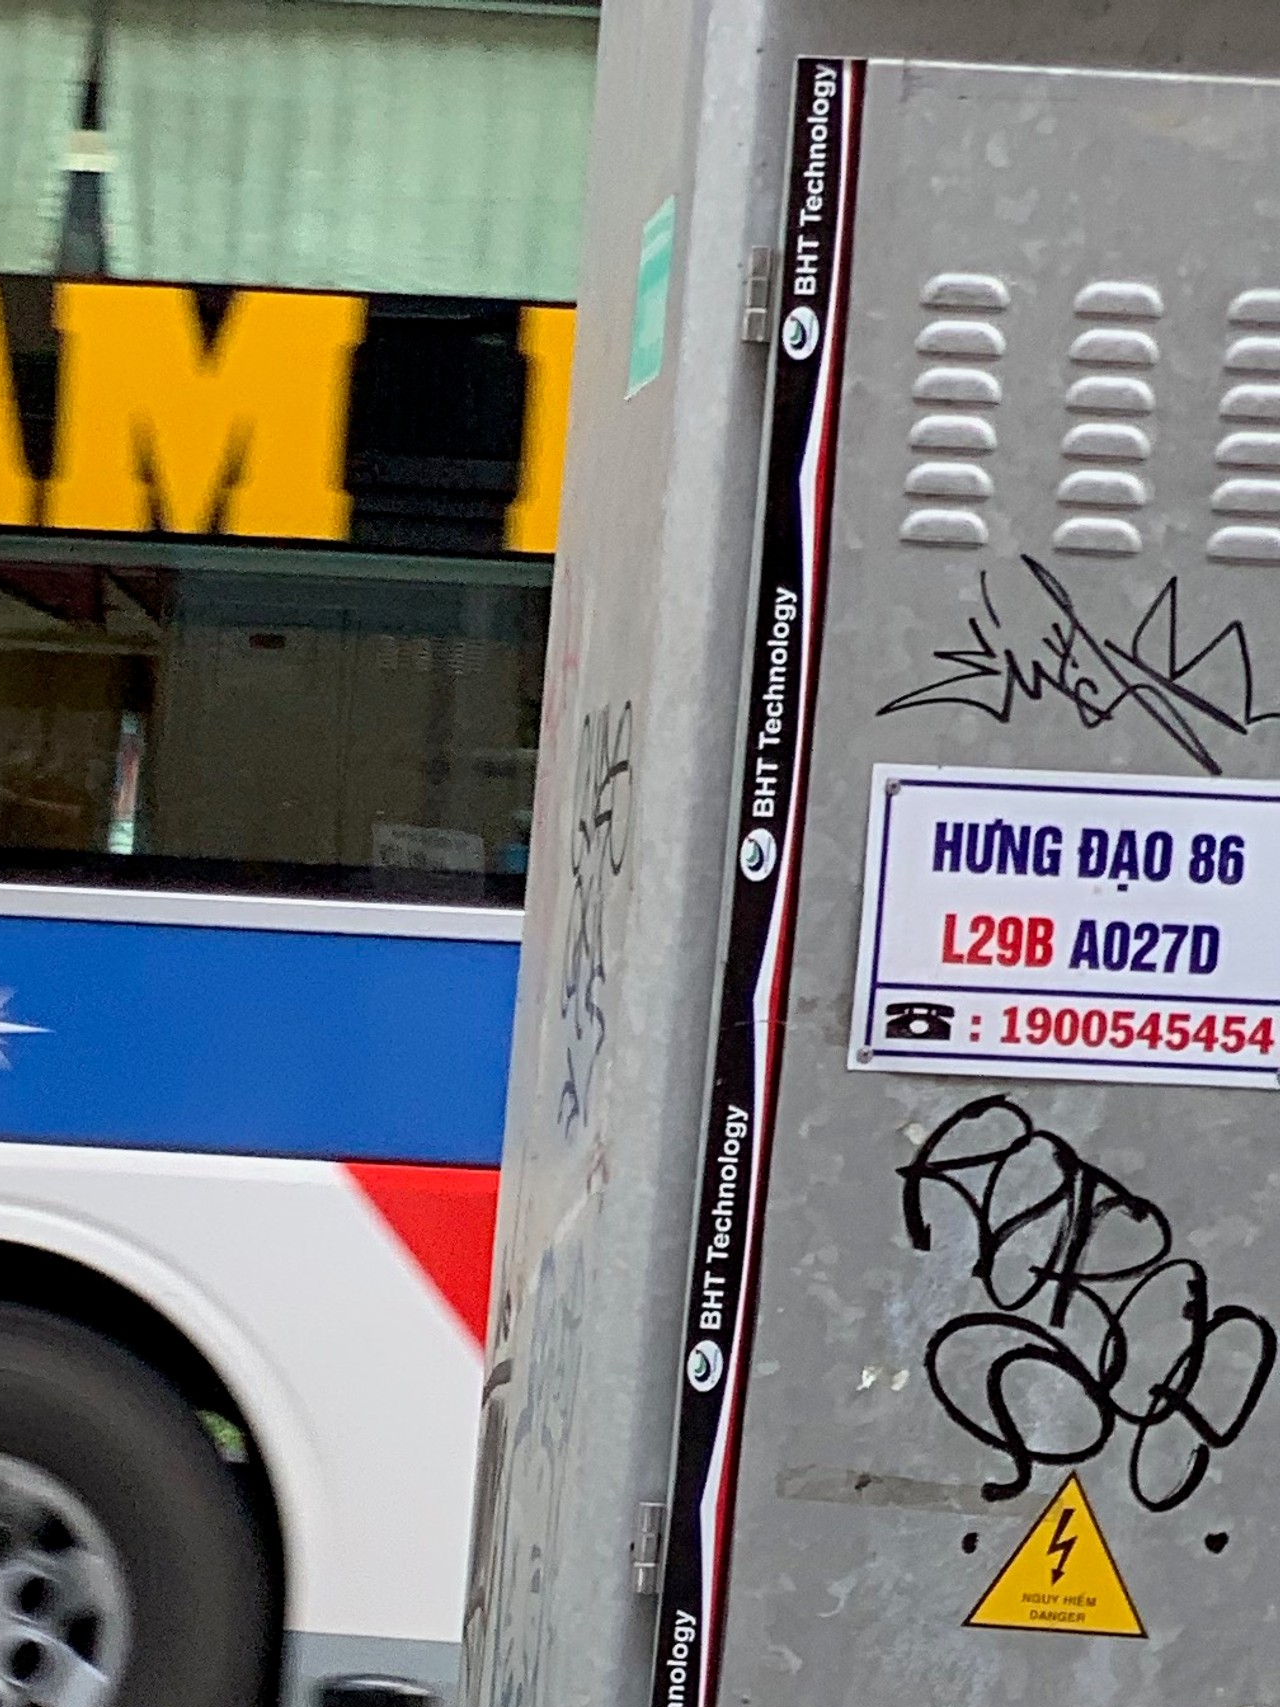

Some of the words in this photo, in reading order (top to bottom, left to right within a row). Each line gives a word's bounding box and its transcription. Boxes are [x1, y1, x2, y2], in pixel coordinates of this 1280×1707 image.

[797, 62, 838, 227] Technology
[792, 234, 819, 296] BHT
[760, 586, 798, 754] Technology
[753, 762, 781, 819] BHT
[932, 818, 1062, 877] HƯNG
[1077, 828, 1173, 892] ĐẠO
[1188, 834, 1246, 886] 86
[941, 914, 1055, 968] L29B
[1069, 920, 1221, 975] A027D
[1000, 1006, 1275, 1055] 1900545454
[709, 1103, 749, 1260] Technology
[700, 1267, 724, 1331] BHT
[1022, 1593, 1059, 1606] NGUY
[1029, 1609, 1086, 1623] DANGER
